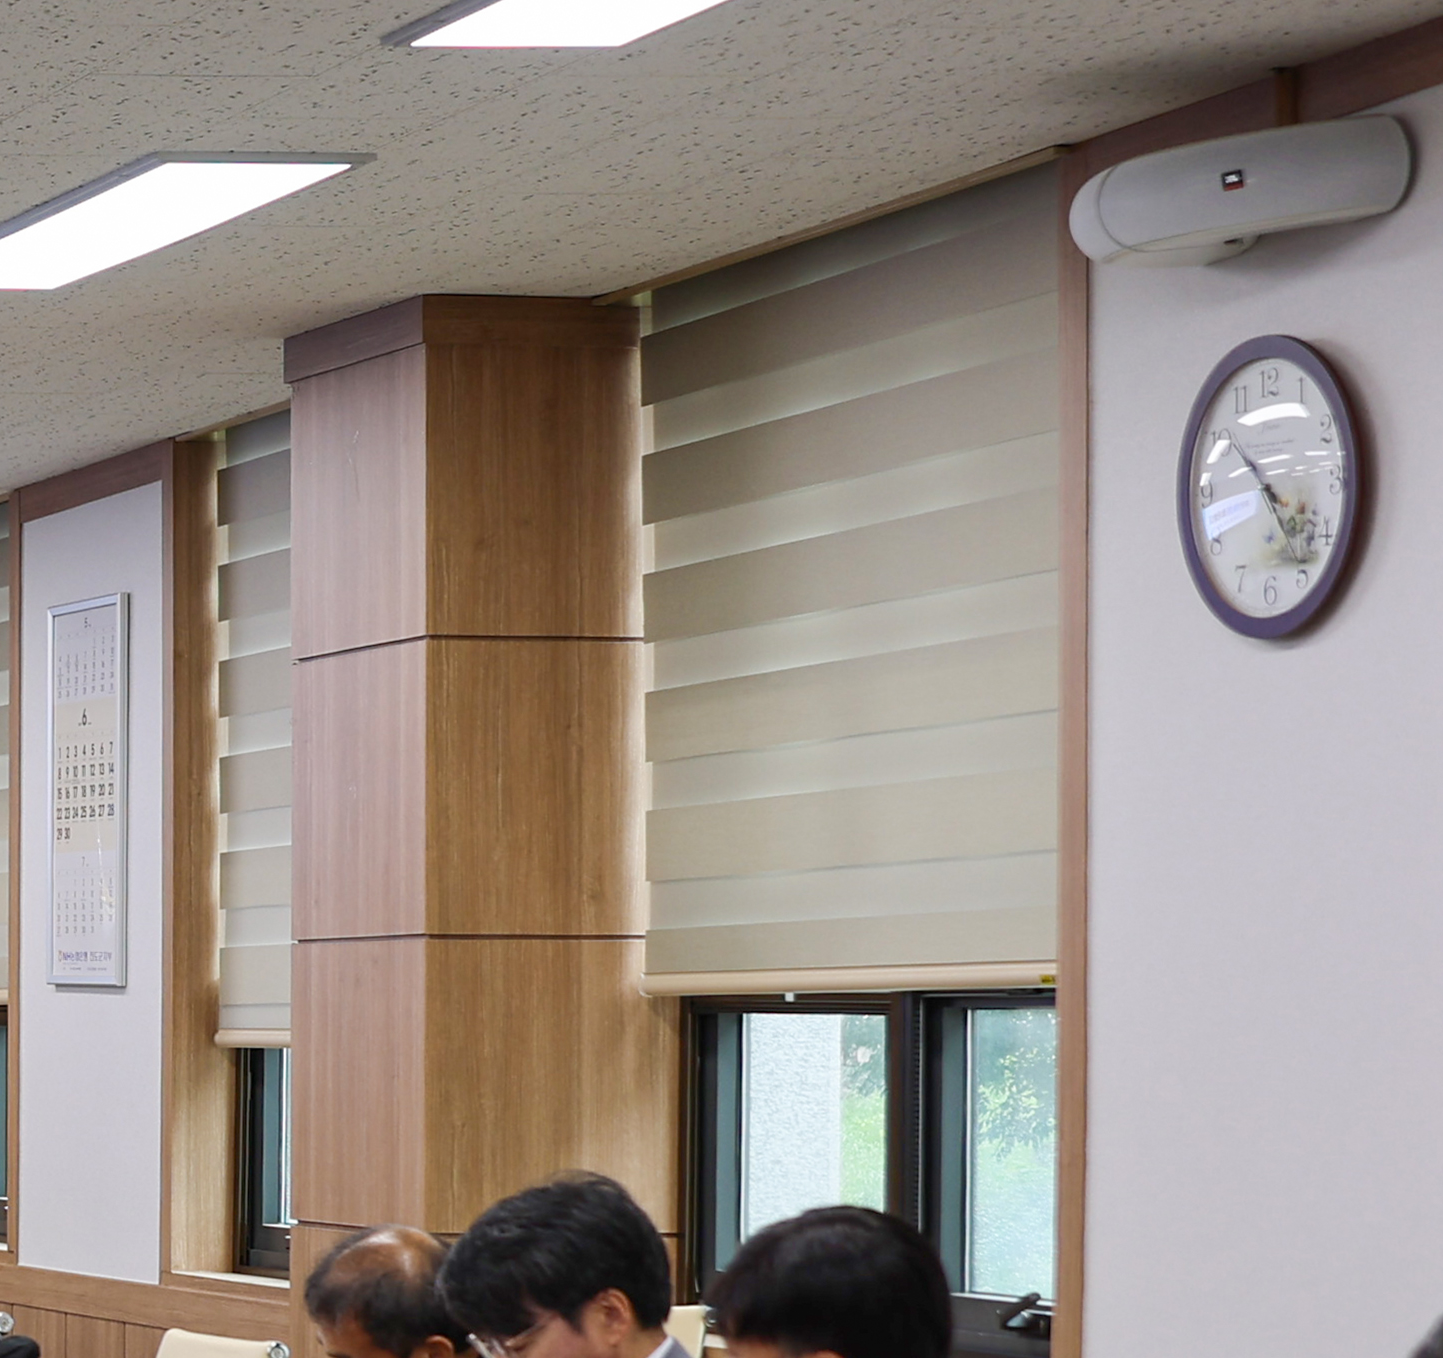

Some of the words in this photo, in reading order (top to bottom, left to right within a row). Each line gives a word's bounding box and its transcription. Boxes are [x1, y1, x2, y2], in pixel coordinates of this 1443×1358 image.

[1260, 367, 1279, 398] 12
[1297, 377, 1307, 404] 1
[1233, 385, 1248, 414] 11
[1210, 428, 1232, 457] 10
[1320, 414, 1333, 444] 2
[1329, 464, 1343, 495] 3
[1201, 482, 1214, 508] 9
[1209, 528, 1222, 556] 8
[1319, 516, 1333, 546] 4
[1235, 565, 1248, 593] 7
[1263, 576, 1277, 605] 6
[1296, 567, 1309, 589] 5
[81, 707, 87, 726] 6
[58, 747, 62, 759] 1
[66, 746, 70, 759] 2
[74, 745, 78, 757] 3
[82, 744, 86, 756] 4
[91, 743, 95, 756] 5
[100, 742, 104, 755] 6
[109, 741, 113, 754] 7
[58, 768, 62, 780] 8
[66, 766, 70, 779] 9
[73, 765, 78, 778] 10
[81, 764, 86, 777] 11
[90, 764, 96, 776] 12
[99, 763, 105, 776] 13
[108, 762, 114, 775] 14
[57, 787, 62, 800] 15
[65, 786, 70, 800] 16
[73, 786, 78, 799] 17
[81, 785, 86, 798] 18
[90, 784, 95, 798] 19
[98, 783, 105, 797] 20
[108, 783, 114, 796] 21
[56, 808, 63, 820] 22
[64, 807, 70, 820] 23
[72, 806, 78, 819] 24
[80, 805, 87, 818] 25
[89, 804, 96, 818] 26
[98, 804, 105, 817] 27
[107, 803, 114, 817] 28
[57, 828, 62, 841] 29
[64, 827, 70, 840] 30
